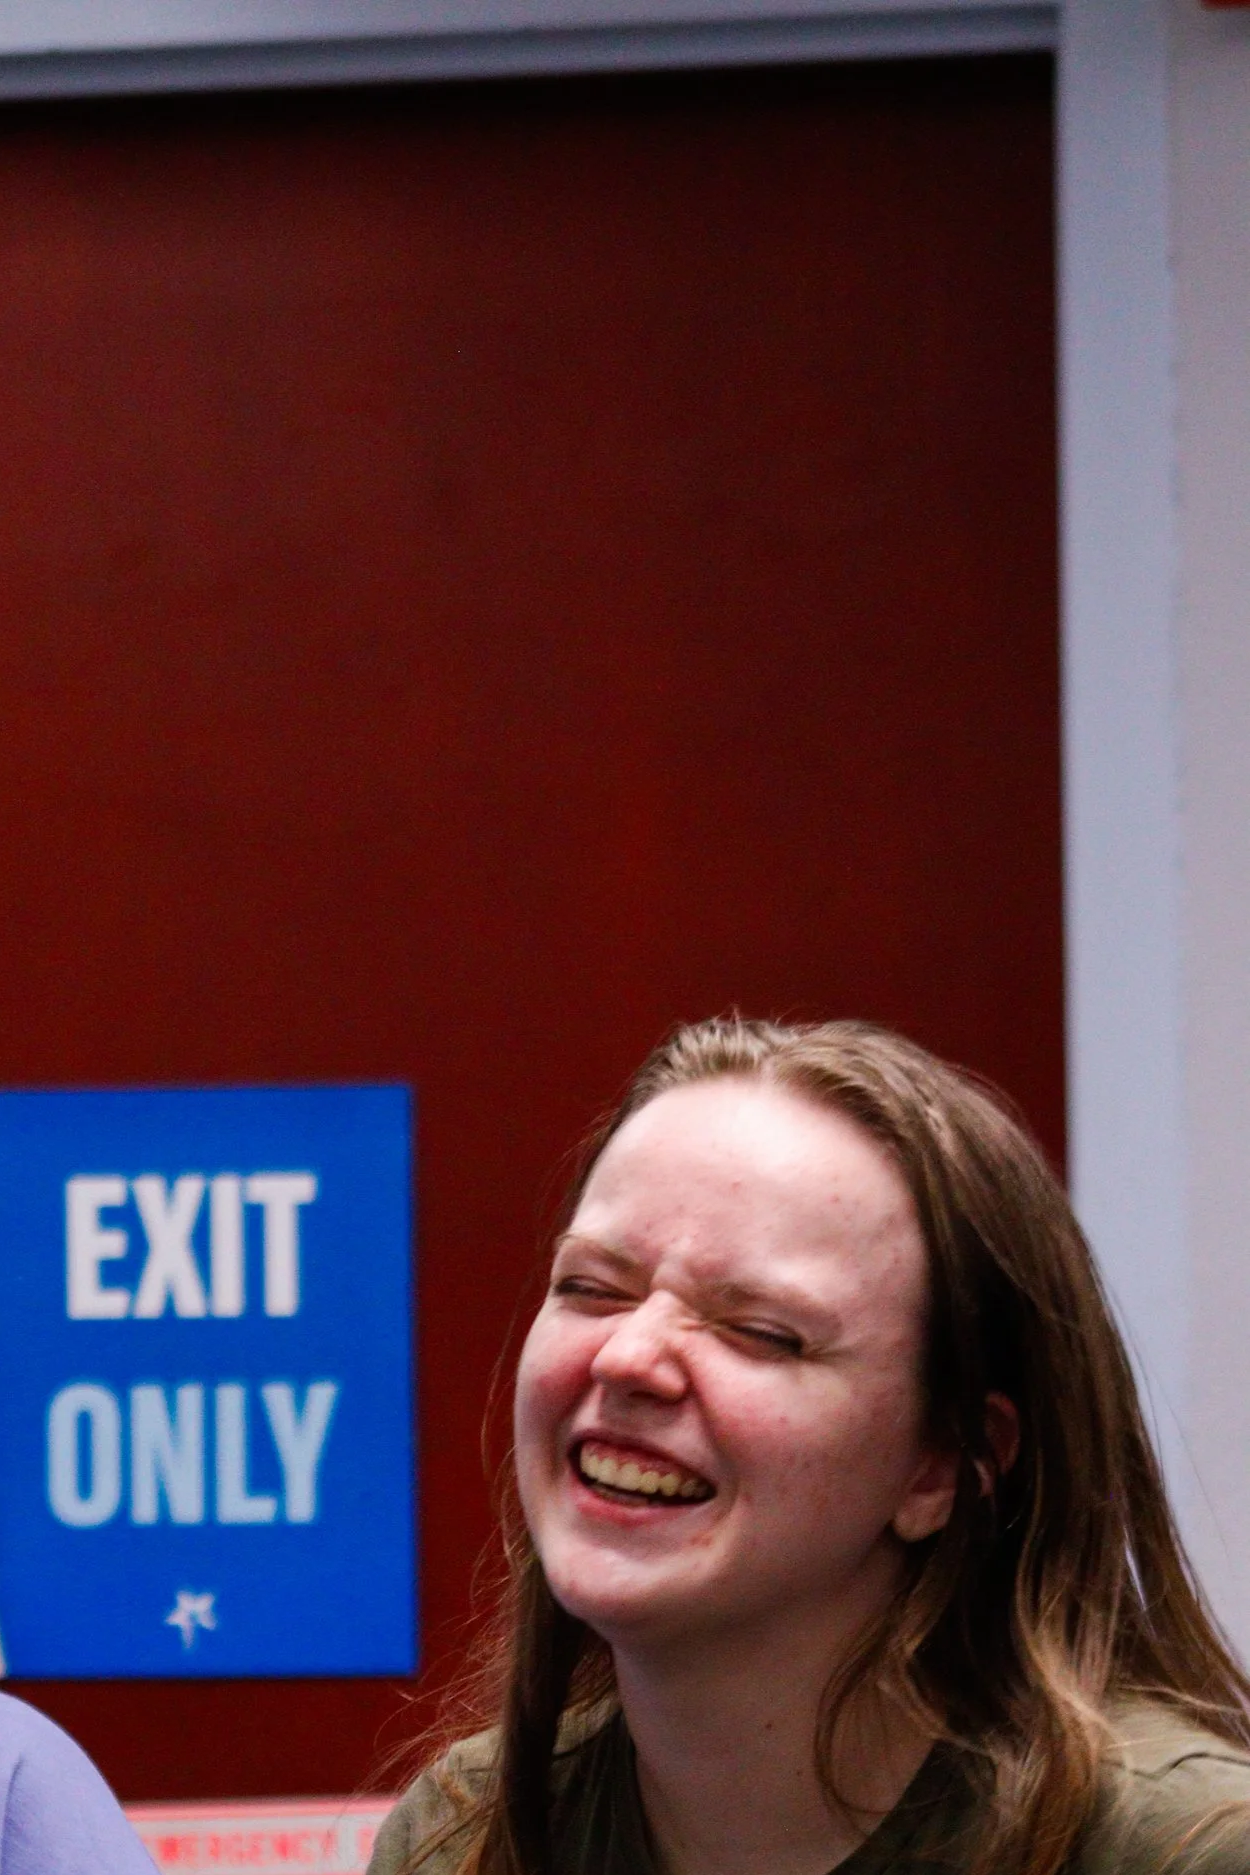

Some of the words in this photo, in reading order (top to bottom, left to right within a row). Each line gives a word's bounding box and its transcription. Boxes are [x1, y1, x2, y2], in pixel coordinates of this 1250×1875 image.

[65, 1171, 317, 1320] EXIT
[48, 1382, 336, 1526] ONLY
[142, 1828, 338, 1869] MERGENCY
